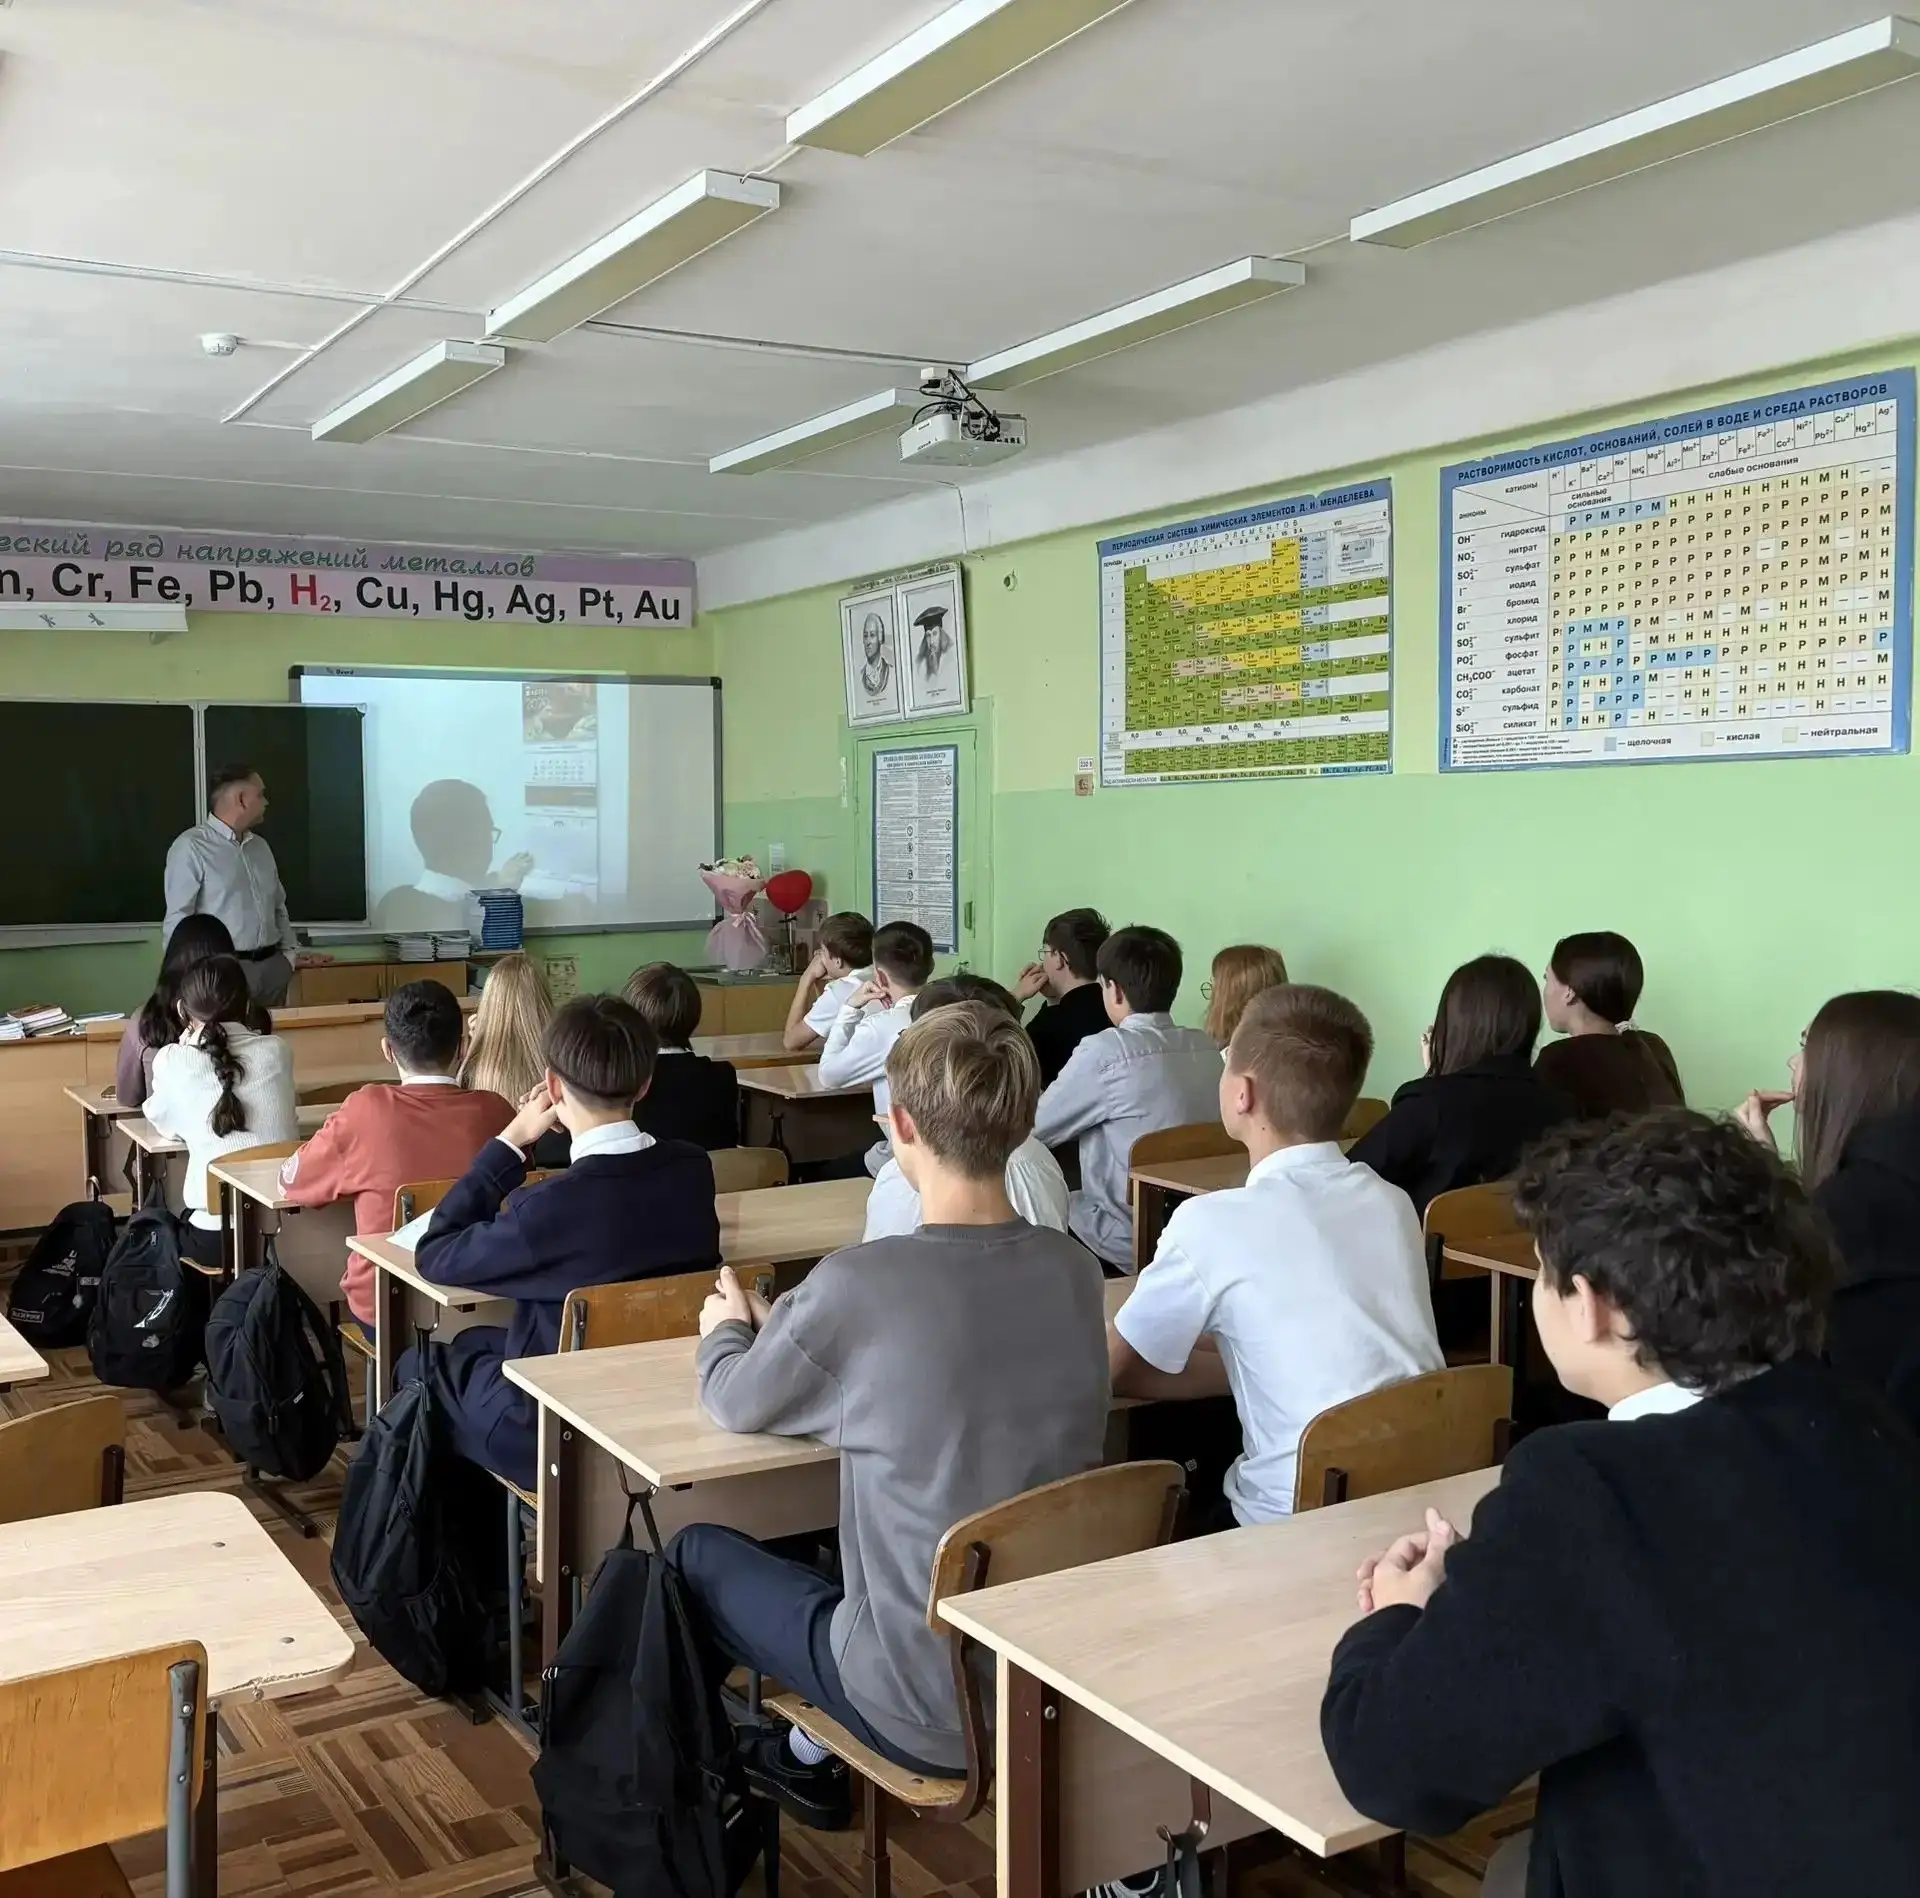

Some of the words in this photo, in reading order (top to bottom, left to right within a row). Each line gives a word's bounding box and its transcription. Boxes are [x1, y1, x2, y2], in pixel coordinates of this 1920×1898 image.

[1458, 457, 1540, 480] РАСТВОРИМОСТЬ
[1543, 446, 1588, 464] КИСЛОТ,
[1590, 430, 1660, 452] ОСНОВАНИЙ,
[1664, 420, 1702, 438] СОЛЕЙ
[1706, 419, 1713, 429] В
[1718, 411, 1749, 426] ВОДЕ
[1754, 410, 1761, 419] И
[1765, 403, 1806, 417] СРЕДА
[1810, 384, 1887, 408] РАСТВОРОВ
[1746, 456, 1799, 471] основания
[1505, 482, 1538, 494] катионы
[1501, 525, 1546, 538] гидроксид
[1570, 517, 1576, 525] Р
[1586, 514, 1592, 522] Р
[1601, 511, 1609, 519] М
[1619, 508, 1625, 516] Р
[1636, 505, 1642, 514] Р
[1652, 502, 1660, 511] М
[1670, 499, 1677, 508] Н
[1688, 496, 1695, 504] Н
[1706, 492, 1712, 501] Н
[1724, 489, 1731, 498] Н
[1743, 486, 1750, 495] Н
[1762, 483, 1769, 492] Н
[1782, 479, 1788, 489] Н
[1801, 476, 1808, 485] Н
[1820, 472, 1829, 483] М
[1841, 469, 1848, 479] Н
[1567, 496, 1612, 510] основания
[1112, 533, 1165, 550] ПЕРИОДИЧЕСКАЯ
[1167, 526, 1198, 540] СИСТЕМА
[1201, 516, 1248, 532] ХИМИЧЕСКИХ
[1251, 506, 1296, 521] ЭЛЕМЕНТОВ
[1320, 489, 1375, 507] МЕНДЕЛЕЕВА
[1458, 509, 1487, 520] анионы
[1509, 544, 1538, 554] нитрат
[1570, 535, 1576, 543] Р
[1586, 532, 1592, 541] Р
[1602, 530, 1608, 538] Р
[1619, 527, 1625, 535] Р
[1636, 524, 1642, 532] Р
[1653, 521, 1659, 530] Р
[1670, 518, 1677, 527] Р
[1688, 515, 1695, 524] Р
[1706, 512, 1713, 521] Р
[1725, 509, 1732, 518] Р
[1744, 506, 1750, 515] Р
[1762, 503, 1770, 512] Р
[1782, 500, 1789, 509] Р
[1801, 497, 1808, 506] Р
[1821, 493, 1828, 503] Р
[1841, 490, 1848, 500] Р
[1862, 487, 1869, 496] Р
[1882, 484, 1890, 493] Р
[104, 534, 164, 561] ряд
[177, 544, 369, 569] напряжений
[380, 554, 534, 576] металлов
[1505, 562, 1540, 573] сульфат
[1509, 580, 1536, 589] иодид
[52, 562, 112, 602] Cr,
[130, 566, 192, 607] Fe,
[209, 569, 274, 610] Pb,
[356, 576, 419, 616] Cu,
[434, 580, 494, 620] Hg,
[506, 584, 566, 624] Ag,
[580, 588, 623, 624] Pt,
[634, 590, 680, 620] Au
[1506, 597, 1539, 608] бромид
[1507, 615, 1538, 624] хлорид
[1505, 632, 1540, 643] сульфит
[1505, 650, 1538, 660] фосфат
[1568, 662, 1574, 671] Р
[1600, 660, 1606, 668] Р
[1634, 656, 1640, 664] Р
[1651, 655, 1657, 663] Р
[1667, 653, 1676, 661] М
[1686, 651, 1692, 660] Р
[1704, 649, 1711, 658] Р
[1722, 648, 1729, 656] Р
[1741, 646, 1748, 654] Р
[1760, 644, 1767, 652] Р
[1780, 642, 1786, 651] Р
[1799, 640, 1806, 649] Р
[1819, 638, 1826, 647] Р
[1839, 636, 1846, 646] Р
[1859, 634, 1866, 644] Р
[1880, 632, 1887, 642] Р
[1502, 685, 1540, 695] карбонат
[1502, 702, 1539, 712] сульфид
[1503, 720, 1537, 729] силикат
[1726, 732, 1760, 742] кислая
[1811, 726, 1878, 738] нейтральная
[1627, 737, 1672, 747] щелочная
